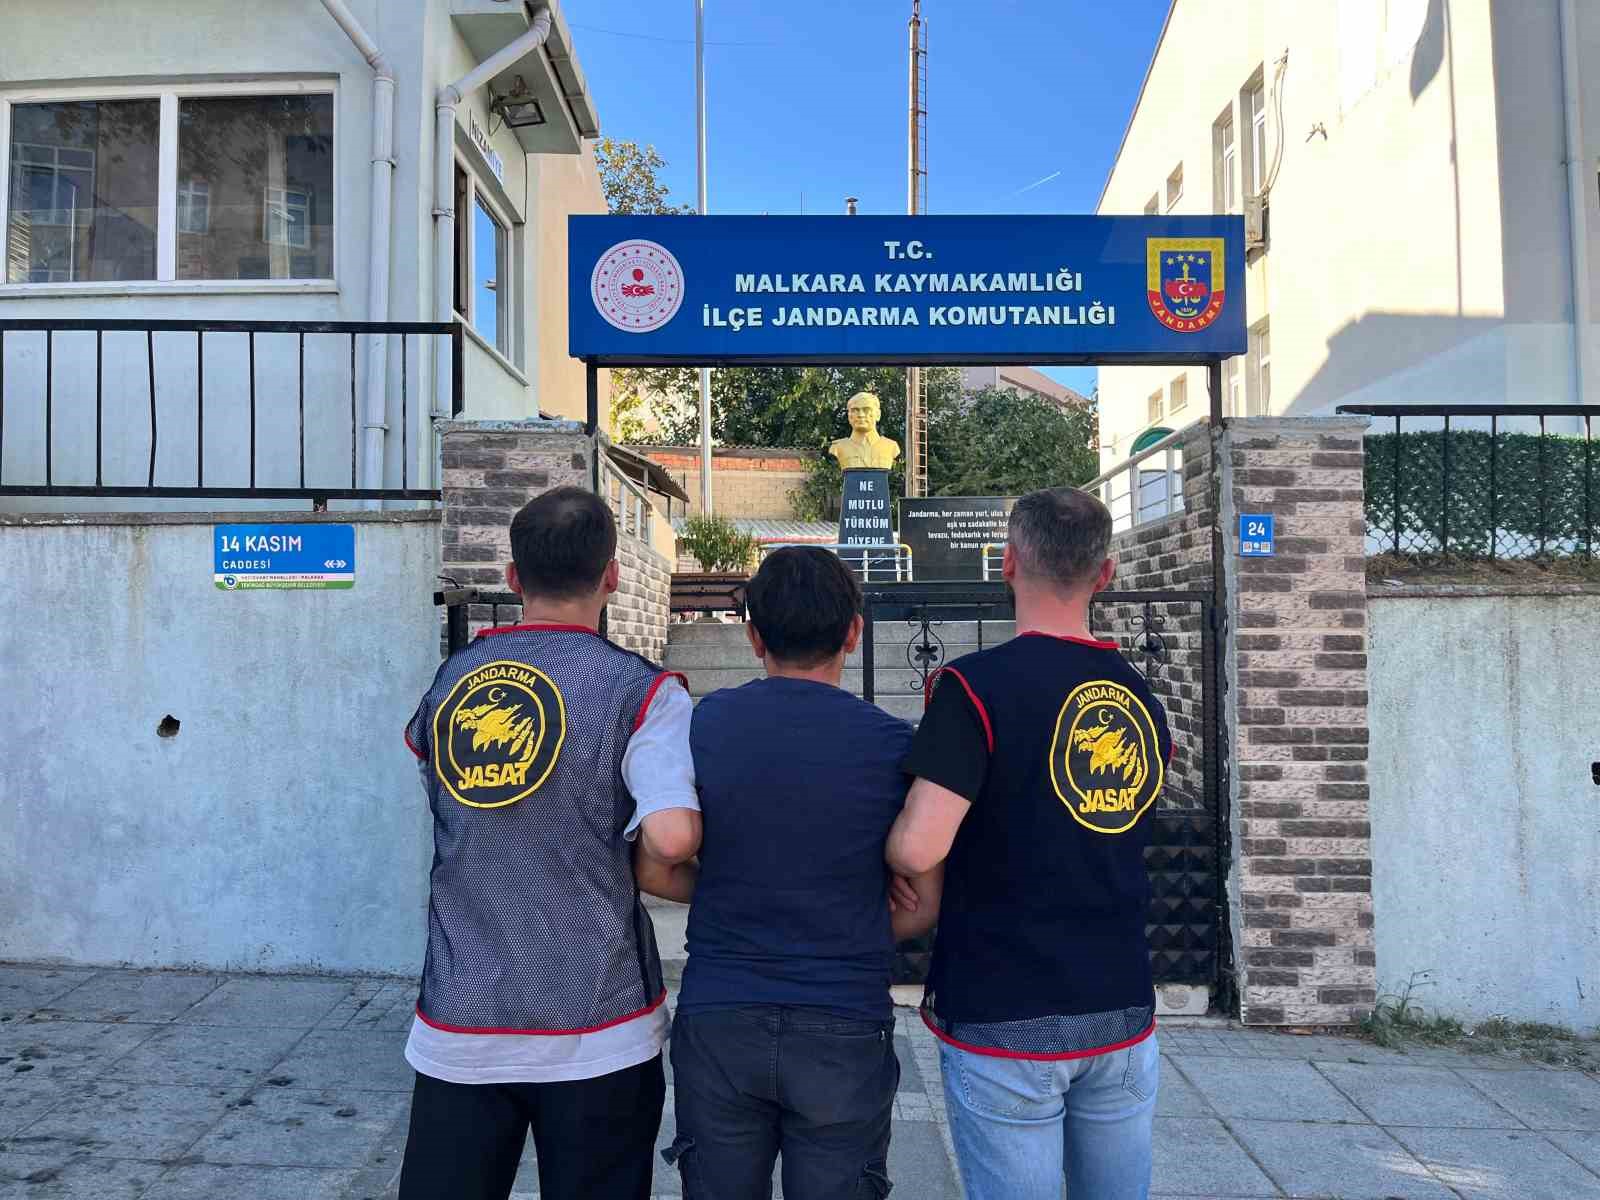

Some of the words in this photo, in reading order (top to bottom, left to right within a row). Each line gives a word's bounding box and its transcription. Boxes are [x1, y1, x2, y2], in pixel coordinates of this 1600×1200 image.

[884, 240, 933, 260] T.C.
[735, 273, 866, 293] MALKARA
[874, 267, 1083, 293] KAYMAKAMLIĞI
[703, 303, 763, 331] İLÇE
[772, 306, 920, 326] JANDARMA
[929, 301, 1116, 325] KOMUTANLIĞI
[1152, 299, 1221, 329] JANDARMA
[859, 481, 874, 492] NE
[848, 499, 884, 511] MUTLU
[844, 515, 889, 529] TÜRKÜM
[1248, 521, 1265, 536] 24
[221, 535, 240, 552] 14
[245, 535, 302, 552] KASIM
[847, 535, 886, 545] DİYENE
[222, 558, 271, 569] CADDESİ
[467, 666, 537, 690] JANDARMA
[1075, 686, 1131, 711] JANDARMA
[457, 762, 530, 791] JASAT
[1079, 786, 1138, 813] JASAT
